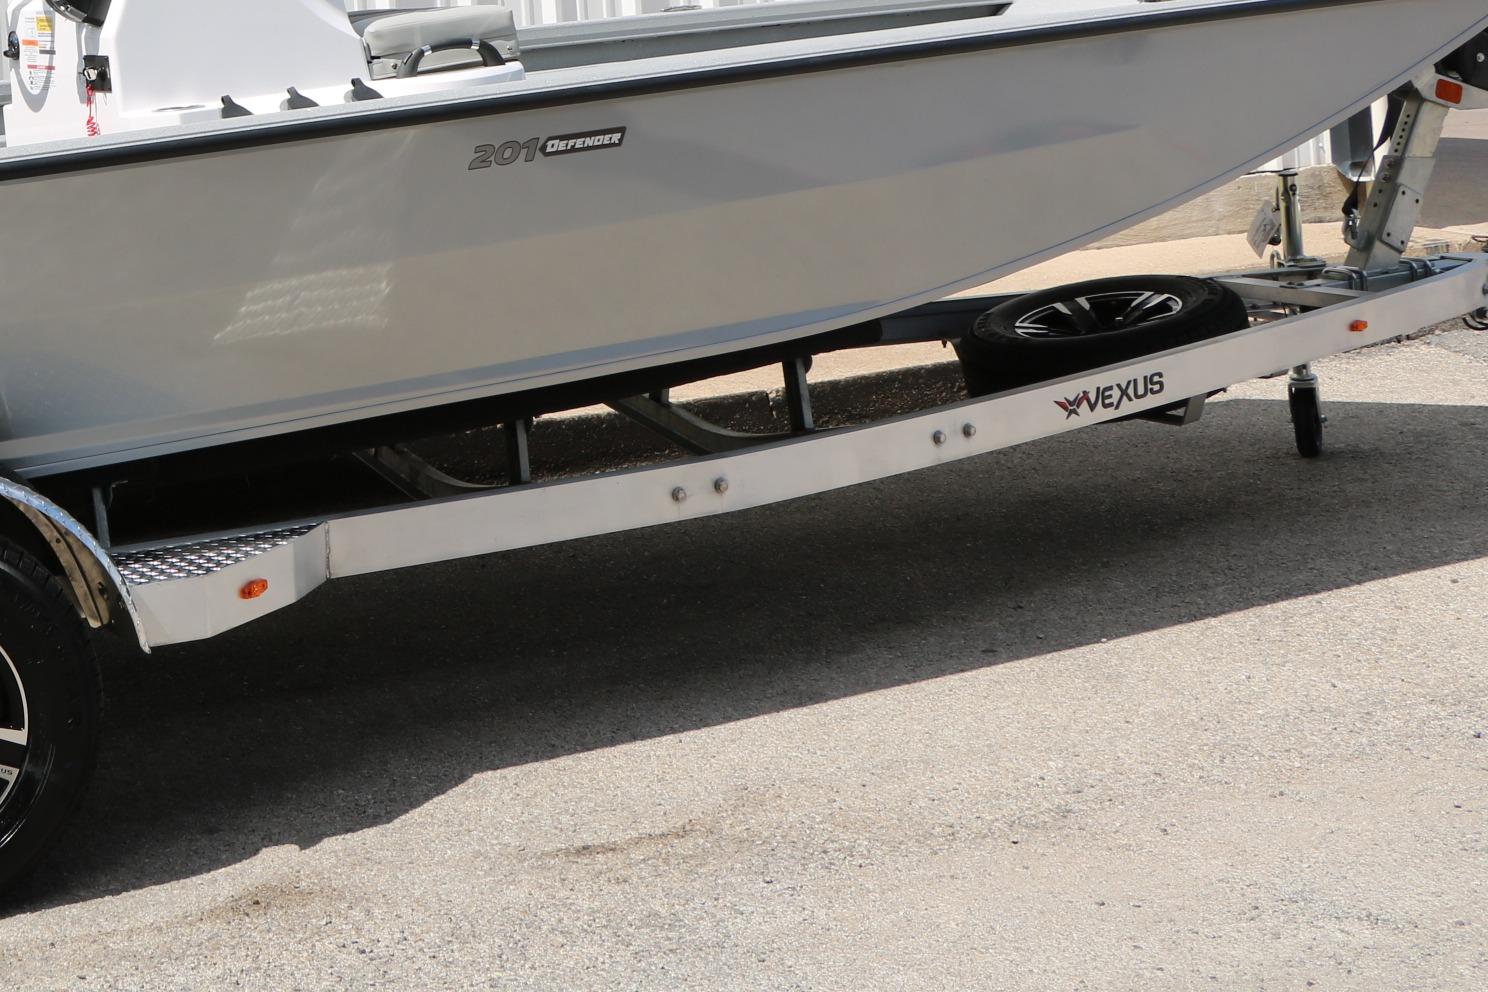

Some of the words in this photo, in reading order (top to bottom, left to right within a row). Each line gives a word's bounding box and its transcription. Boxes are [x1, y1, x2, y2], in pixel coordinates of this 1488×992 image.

[467, 137, 540, 170] 201
[545, 132, 622, 153] DEFENDER
[1081, 371, 1165, 412] VEXUS
